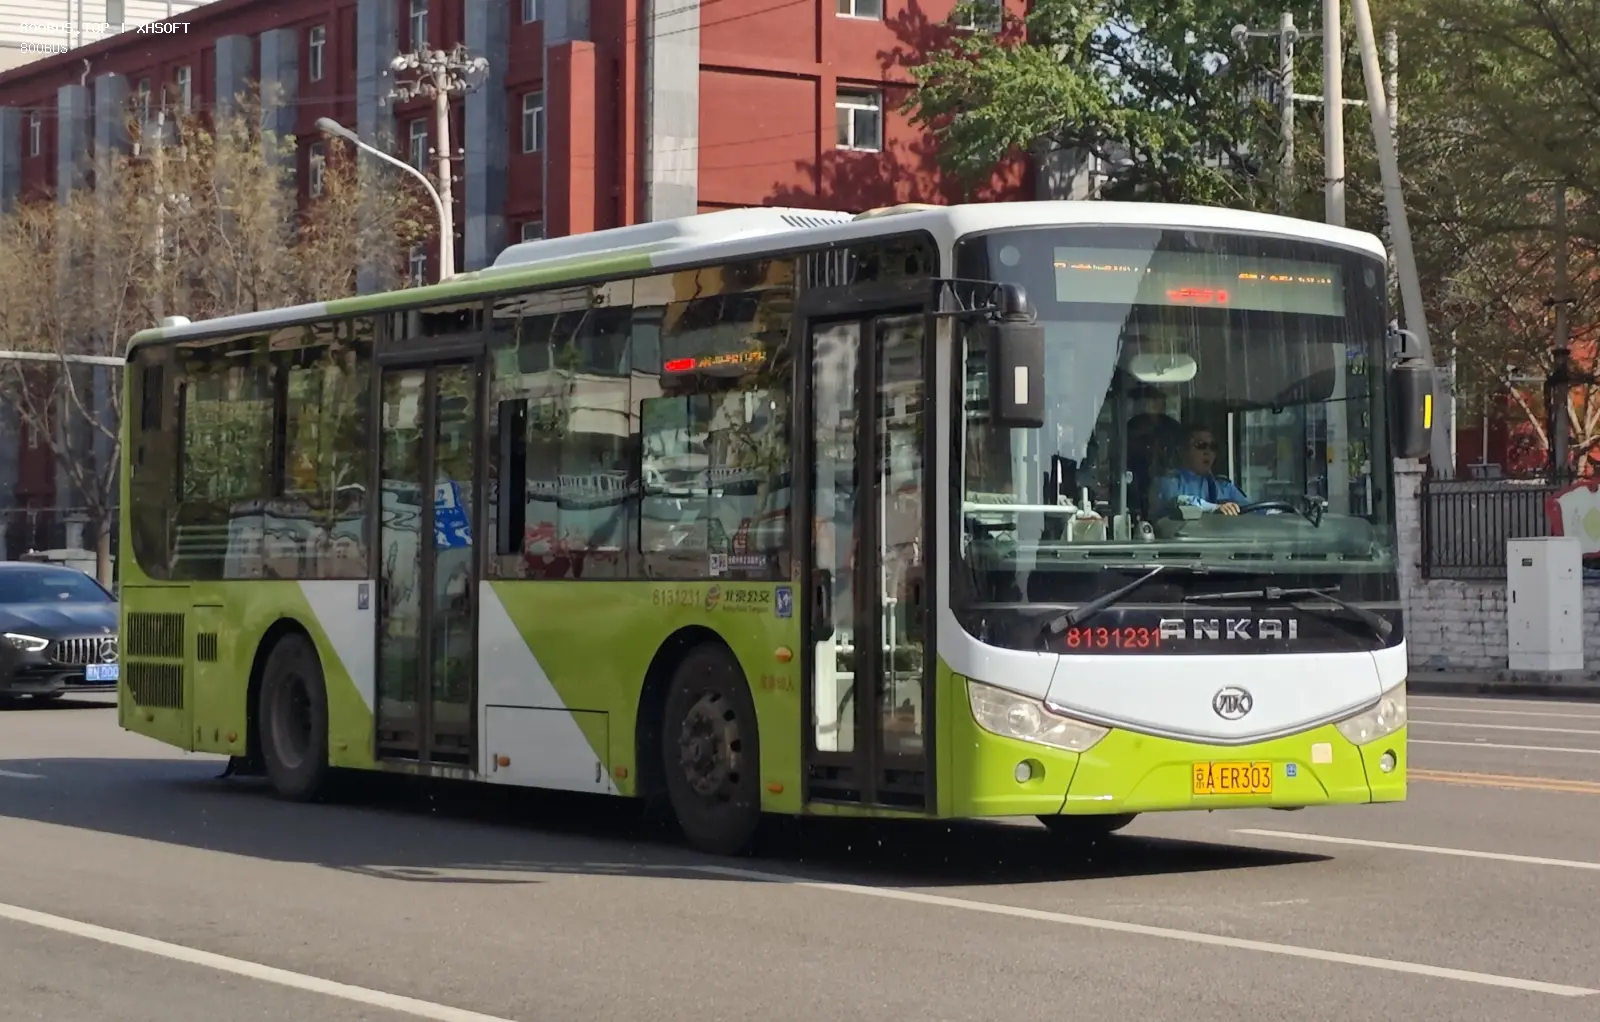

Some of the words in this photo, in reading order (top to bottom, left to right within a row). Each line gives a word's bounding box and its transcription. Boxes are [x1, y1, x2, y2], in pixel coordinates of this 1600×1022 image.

[652, 589, 700, 607] 8131231
[725, 590, 771, 603] 北京公交
[1067, 627, 1161, 649] 8131231
[1159, 618, 1298, 640] ANKAI
